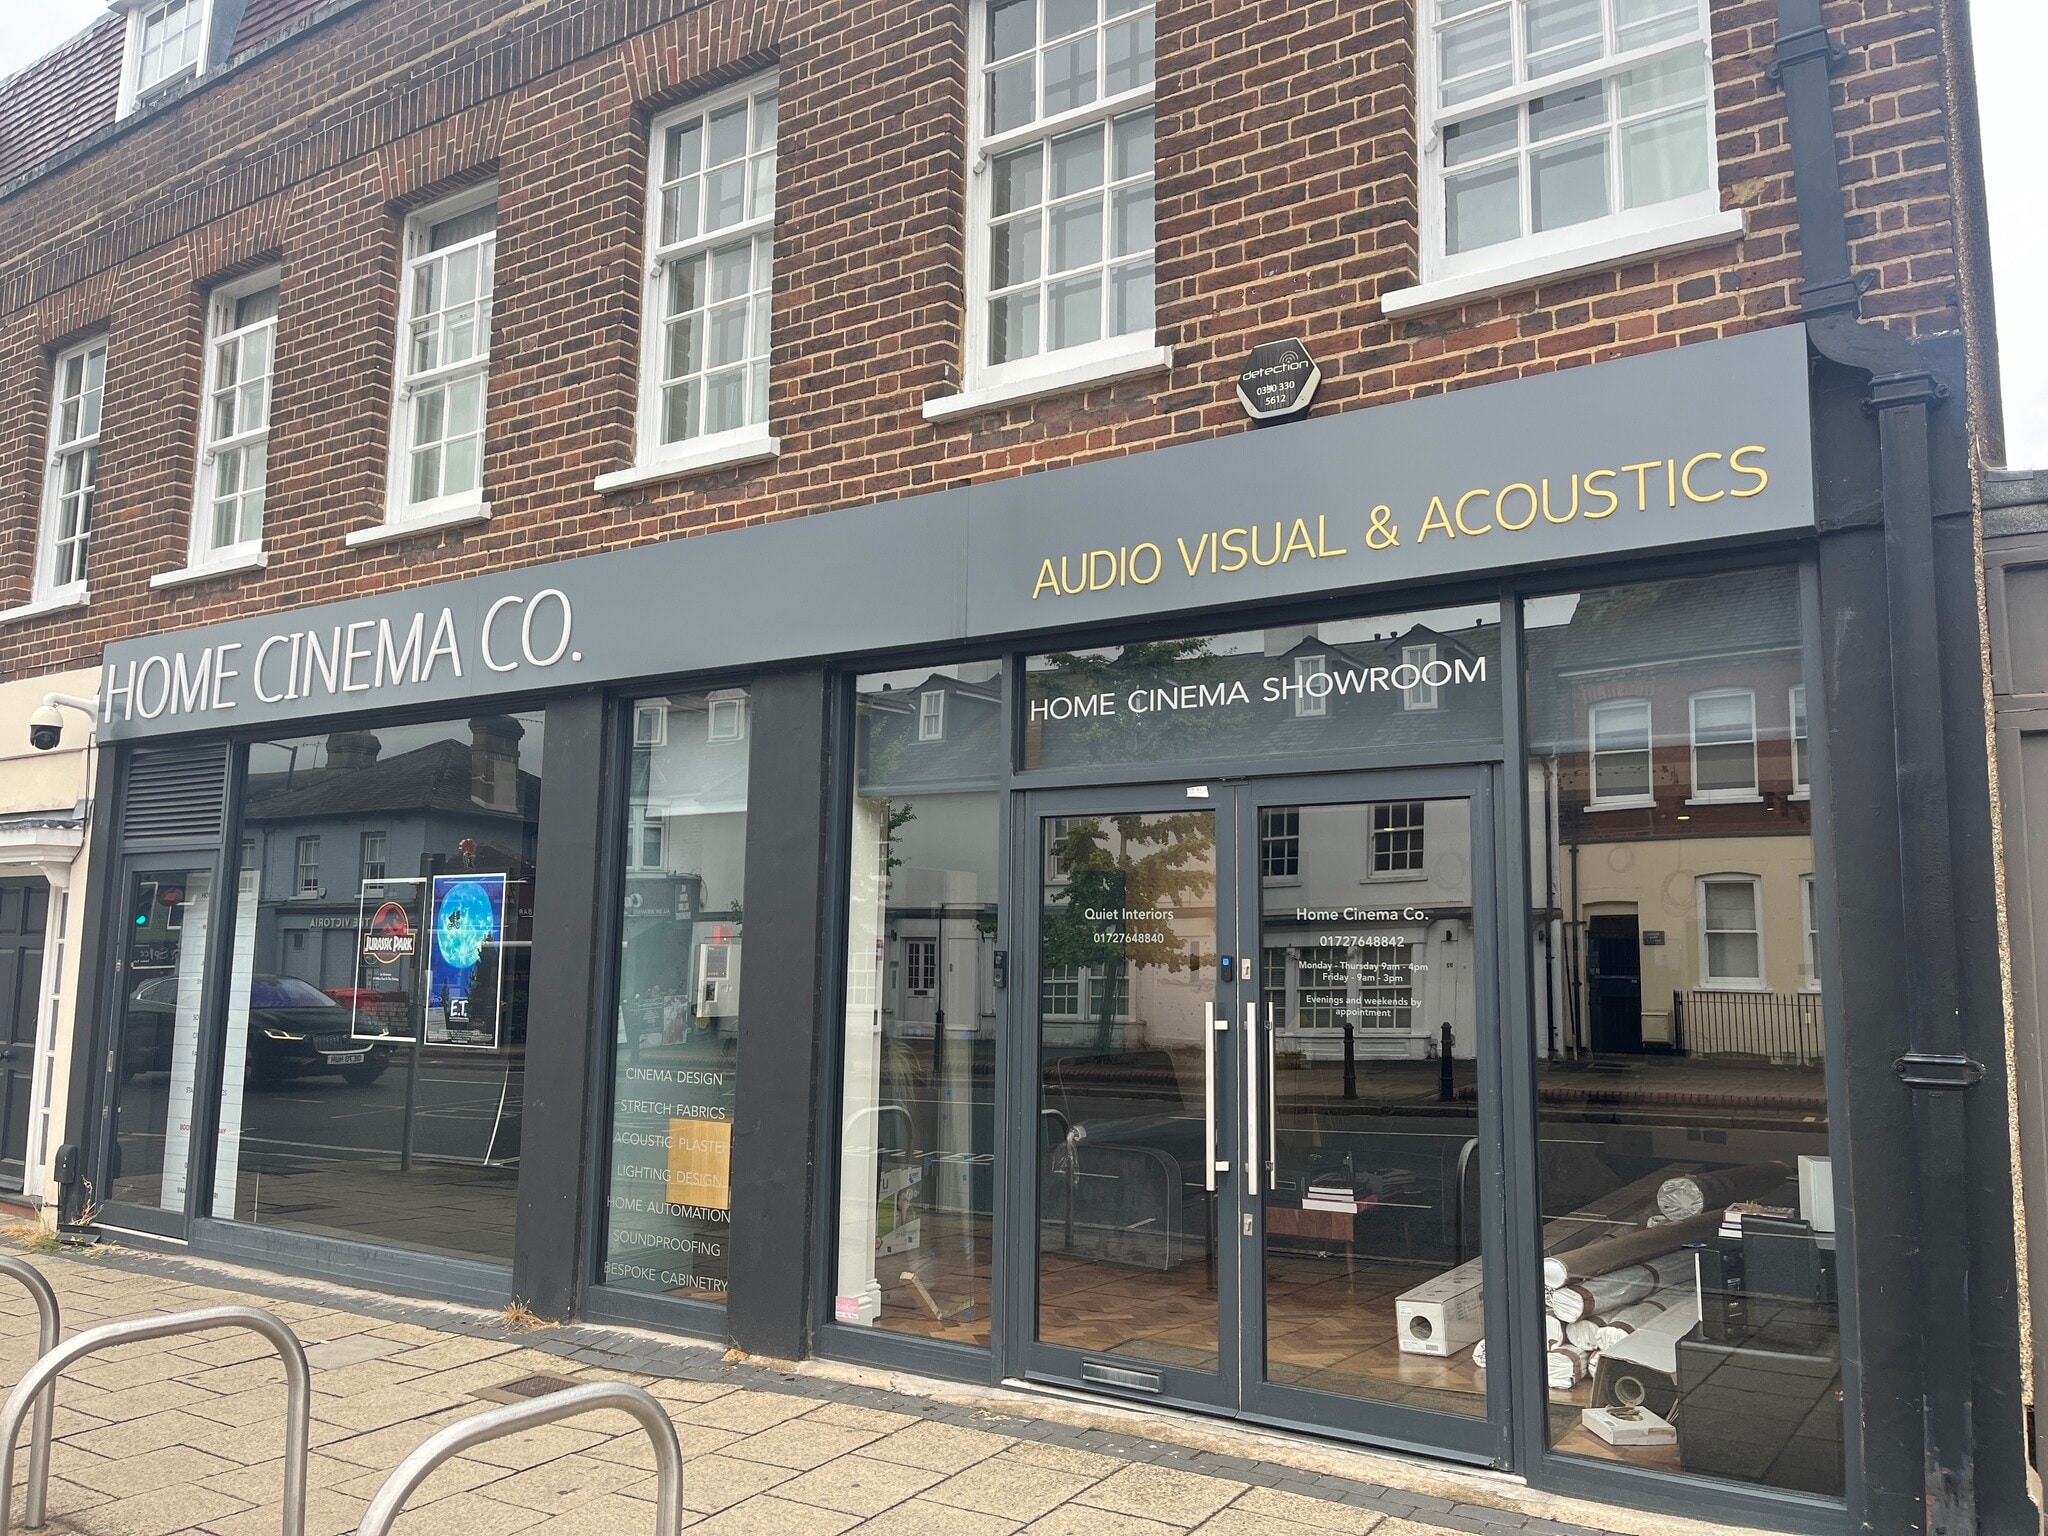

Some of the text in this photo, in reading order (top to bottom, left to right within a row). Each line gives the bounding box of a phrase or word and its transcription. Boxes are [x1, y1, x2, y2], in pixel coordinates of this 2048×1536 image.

[1243, 360, 1308, 381] detection
[1279, 380, 1295, 391] 330
[1265, 394, 1286, 405] 5612
[1032, 444, 1770, 600] AUDIO VISUAL & ACOUSTICS
[103, 588, 583, 724] HOME CINEMA CO.
[1030, 656, 1487, 722] HOME CINEMA SHOWROOM
[1084, 907, 1174, 920] Quiet Interiors
[1296, 907, 1429, 921] Home Cinema Co.
[364, 935, 413, 952] JURASSIC PARK
[1093, 933, 1164, 944] 01727648840
[1319, 935, 1405, 948] 01727648842
[1298, 961, 1333, 972] Monday
[1340, 961, 1379, 972] Thursday
[1381, 962, 1400, 971] 9am
[1408, 962, 1429, 973] 4pm
[1322, 972, 1349, 984] Friday
[1356, 973, 1376, 982] 9am
[1383, 974, 1403, 984] 3pm
[450, 999, 469, 1017] E.T.
[1306, 995, 1422, 1008] Evenings and weekends by
[1335, 1007, 1392, 1017] appointment
[625, 1067, 723, 1086] CINEMA DESIGN
[620, 1099, 726, 1120] STRETCH FABRICS
[613, 1131, 673, 1149] ACOUSTIC
[617, 1164, 723, 1187] LIGHTING DESIGN
[606, 1195, 731, 1224] HOME AUTOMATION
[613, 1229, 721, 1257] SOUNDPROOFING
[604, 1261, 729, 1293] BESPOKE CABINETRY
